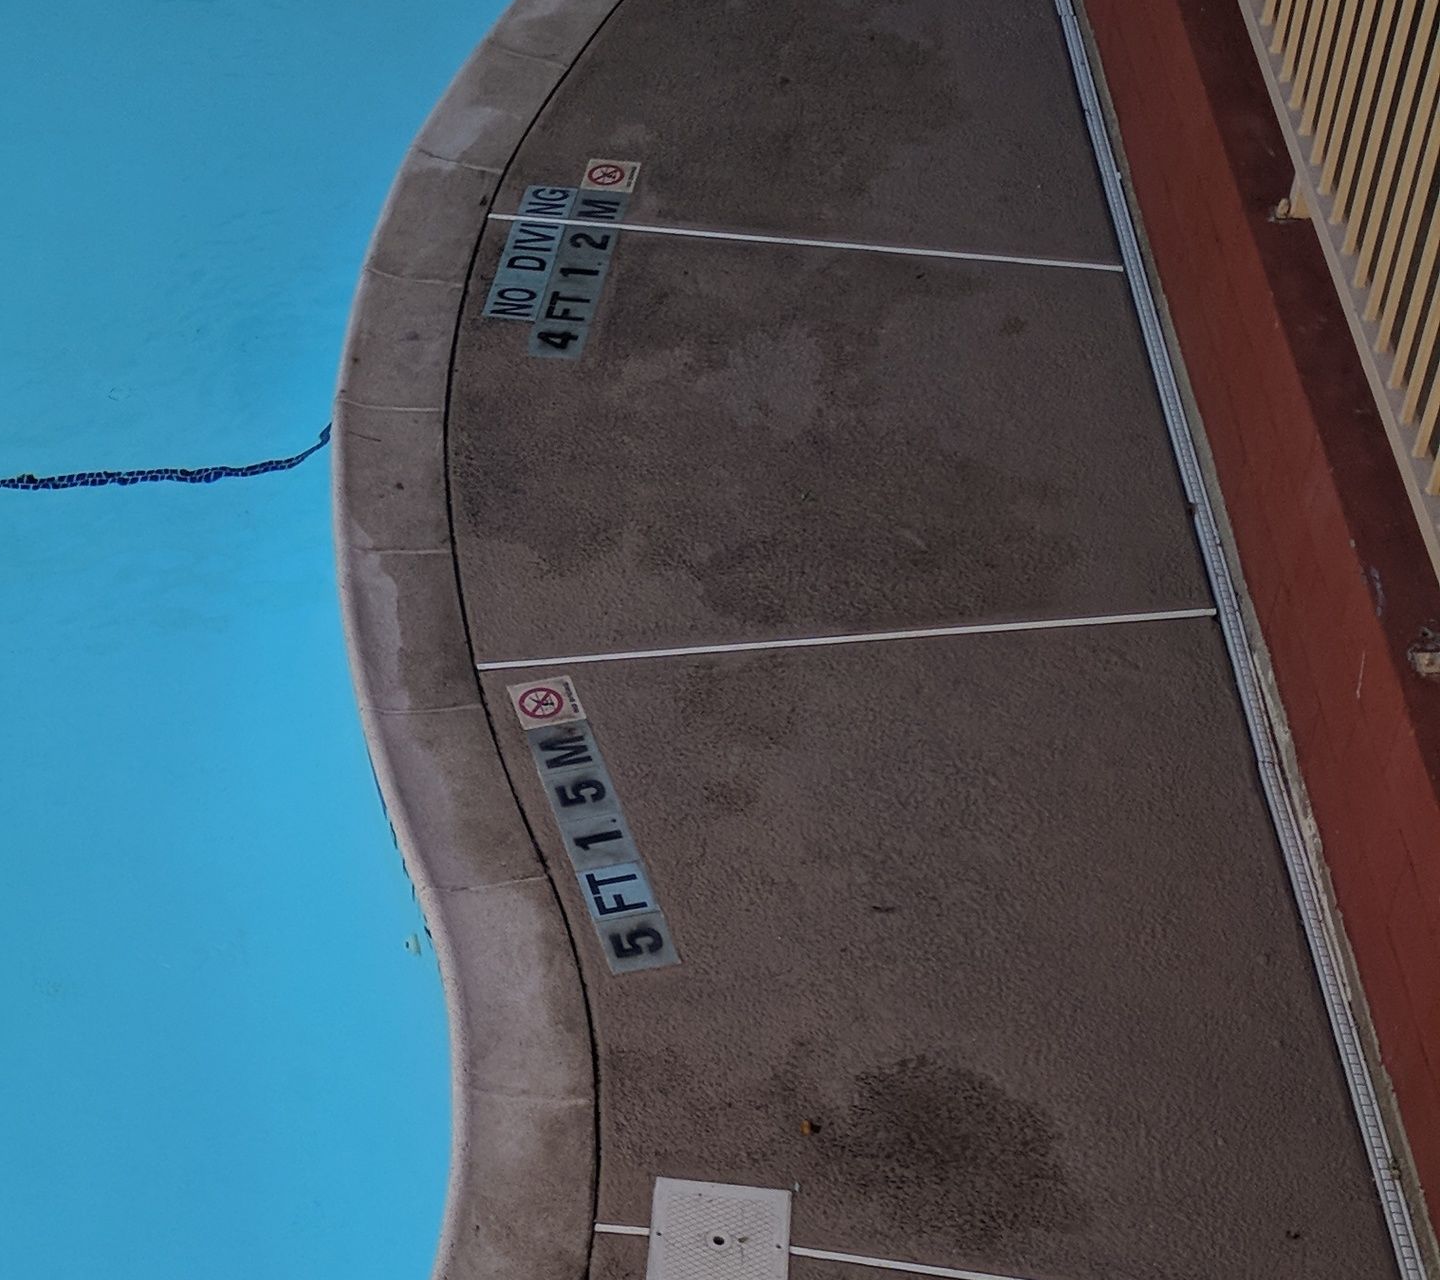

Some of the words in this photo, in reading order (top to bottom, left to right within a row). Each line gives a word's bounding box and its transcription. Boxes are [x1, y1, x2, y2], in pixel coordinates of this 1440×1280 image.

[578, 198, 621, 220] M
[506, 187, 571, 272] DIVING
[490, 287, 538, 318] NO
[545, 290, 591, 322] FT
[537, 329, 579, 350] 4
[538, 734, 593, 770] M
[585, 872, 648, 916] FT
[610, 926, 664, 960] 5
